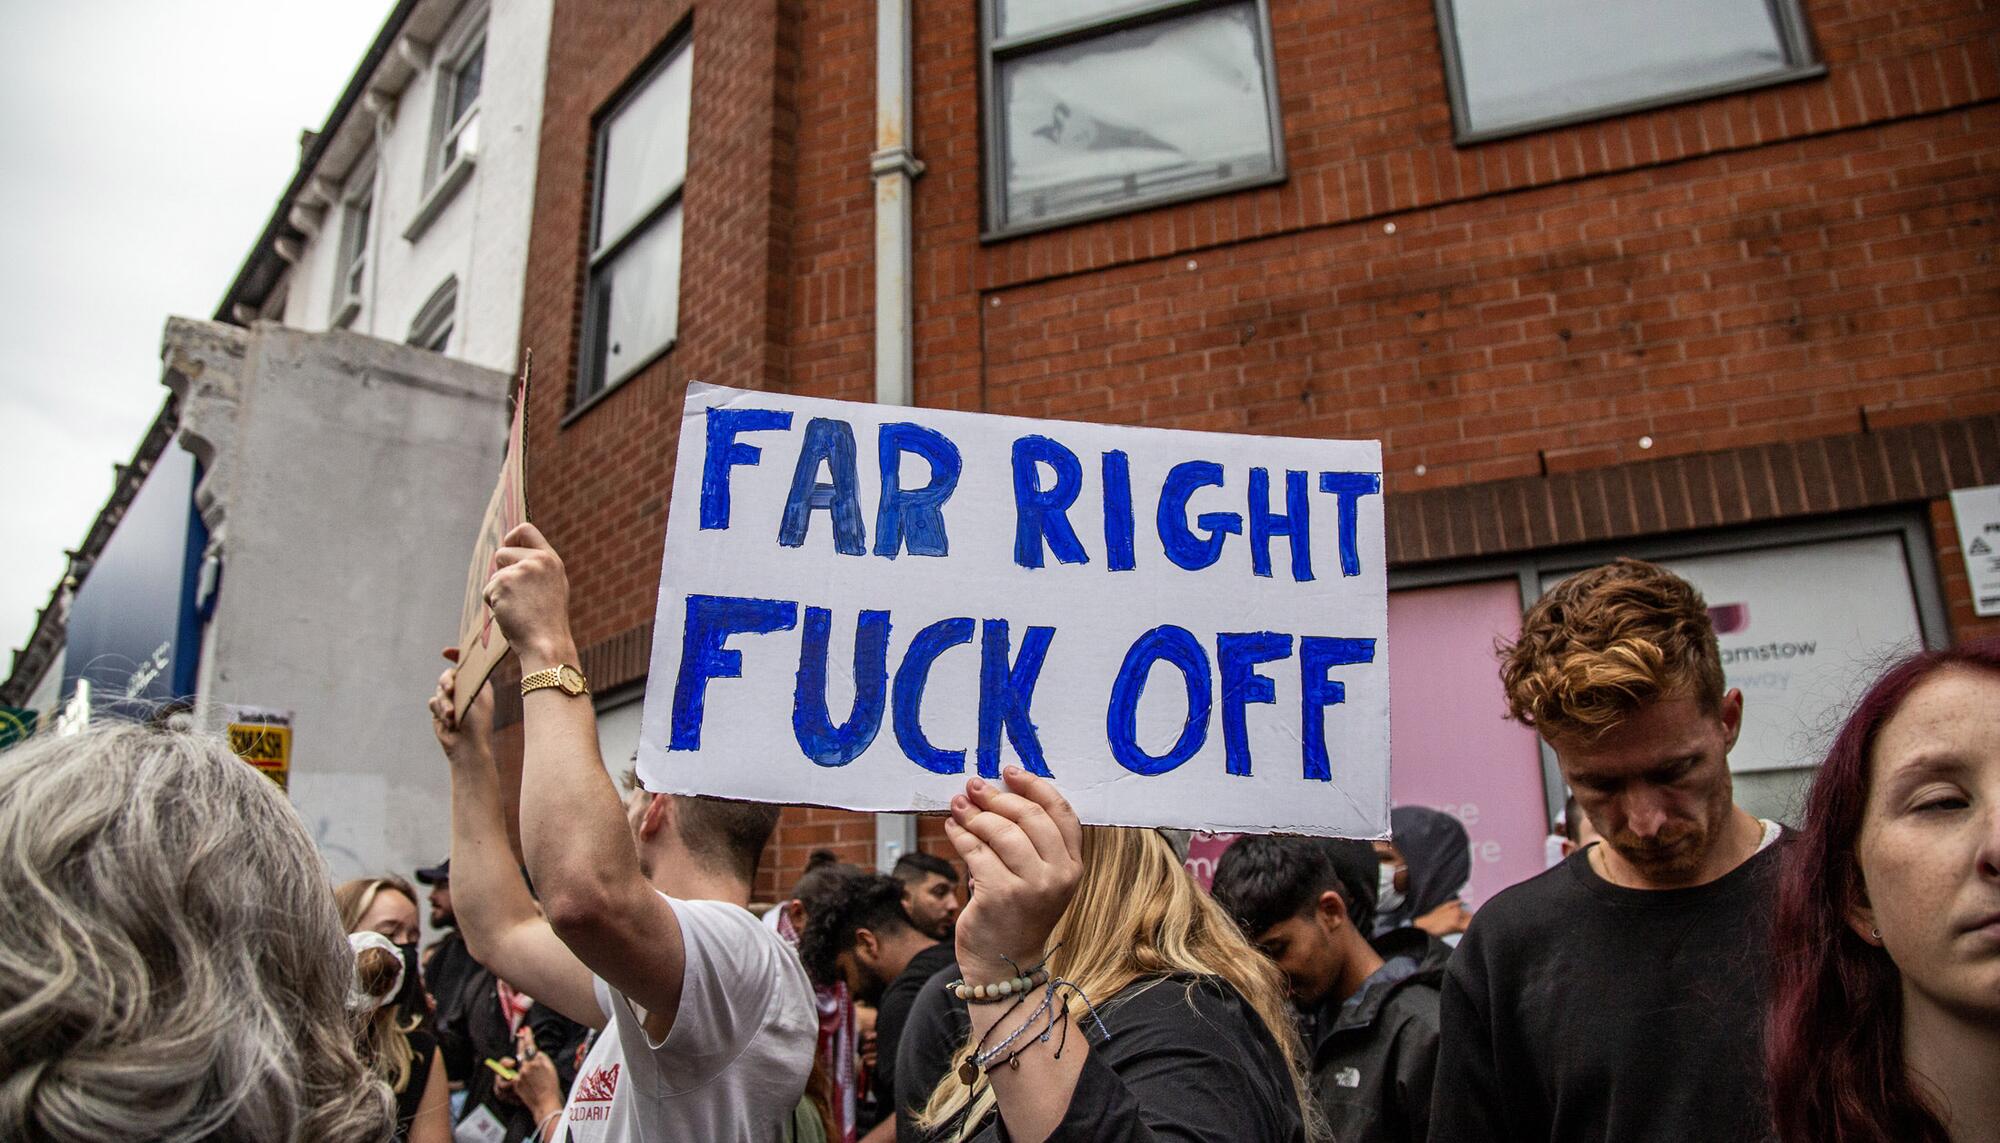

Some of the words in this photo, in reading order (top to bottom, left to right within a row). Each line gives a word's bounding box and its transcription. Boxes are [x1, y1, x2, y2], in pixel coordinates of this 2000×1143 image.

[699, 406, 963, 561] FAR
[1011, 434, 1381, 582] RIGHT
[668, 593, 1057, 780] FUCK
[1106, 624, 1376, 783] OFF
[1720, 641, 1817, 665] amstow
